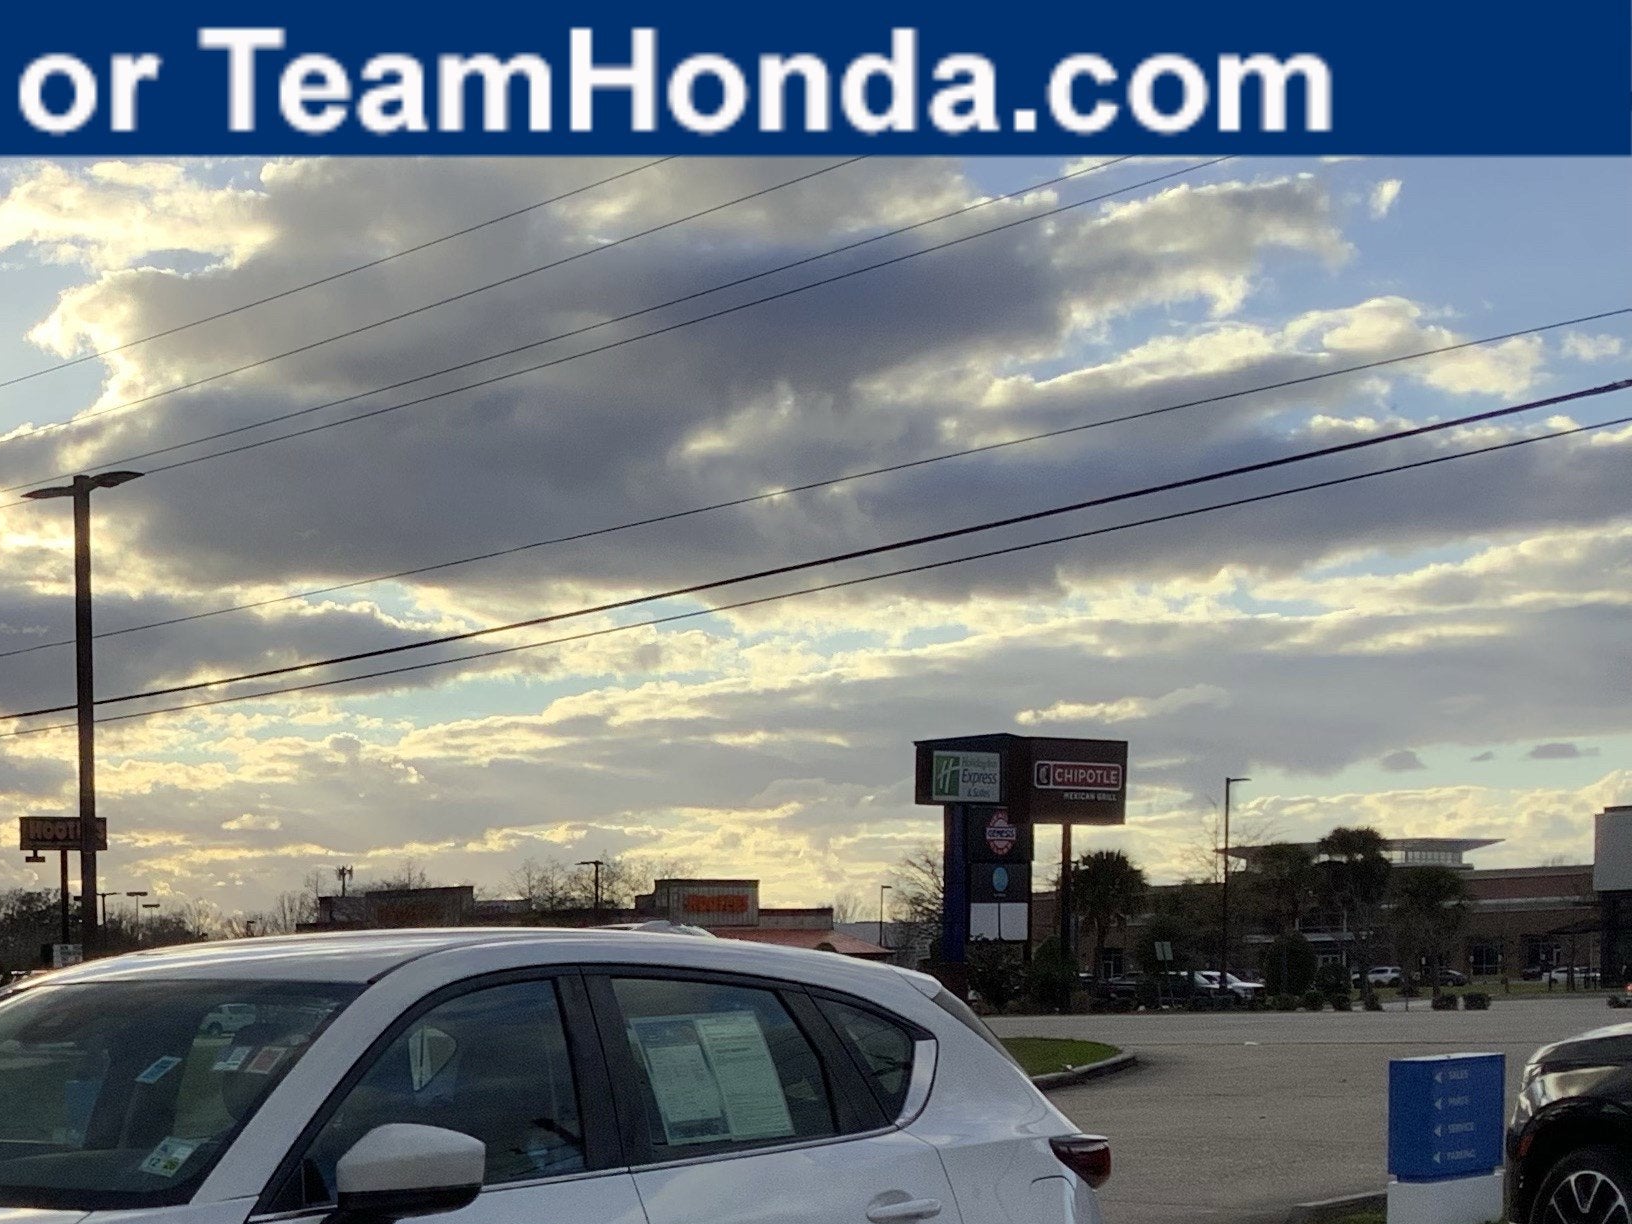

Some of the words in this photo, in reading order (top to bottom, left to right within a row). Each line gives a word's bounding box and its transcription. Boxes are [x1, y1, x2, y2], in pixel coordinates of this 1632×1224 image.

[962, 770, 997, 786] Express
[1055, 769, 1118, 784] CHIPOTLE
[1063, 792, 1096, 801] MEXICAN
[1097, 793, 1117, 801] GRILL
[987, 829, 1015, 838] GENESIS
